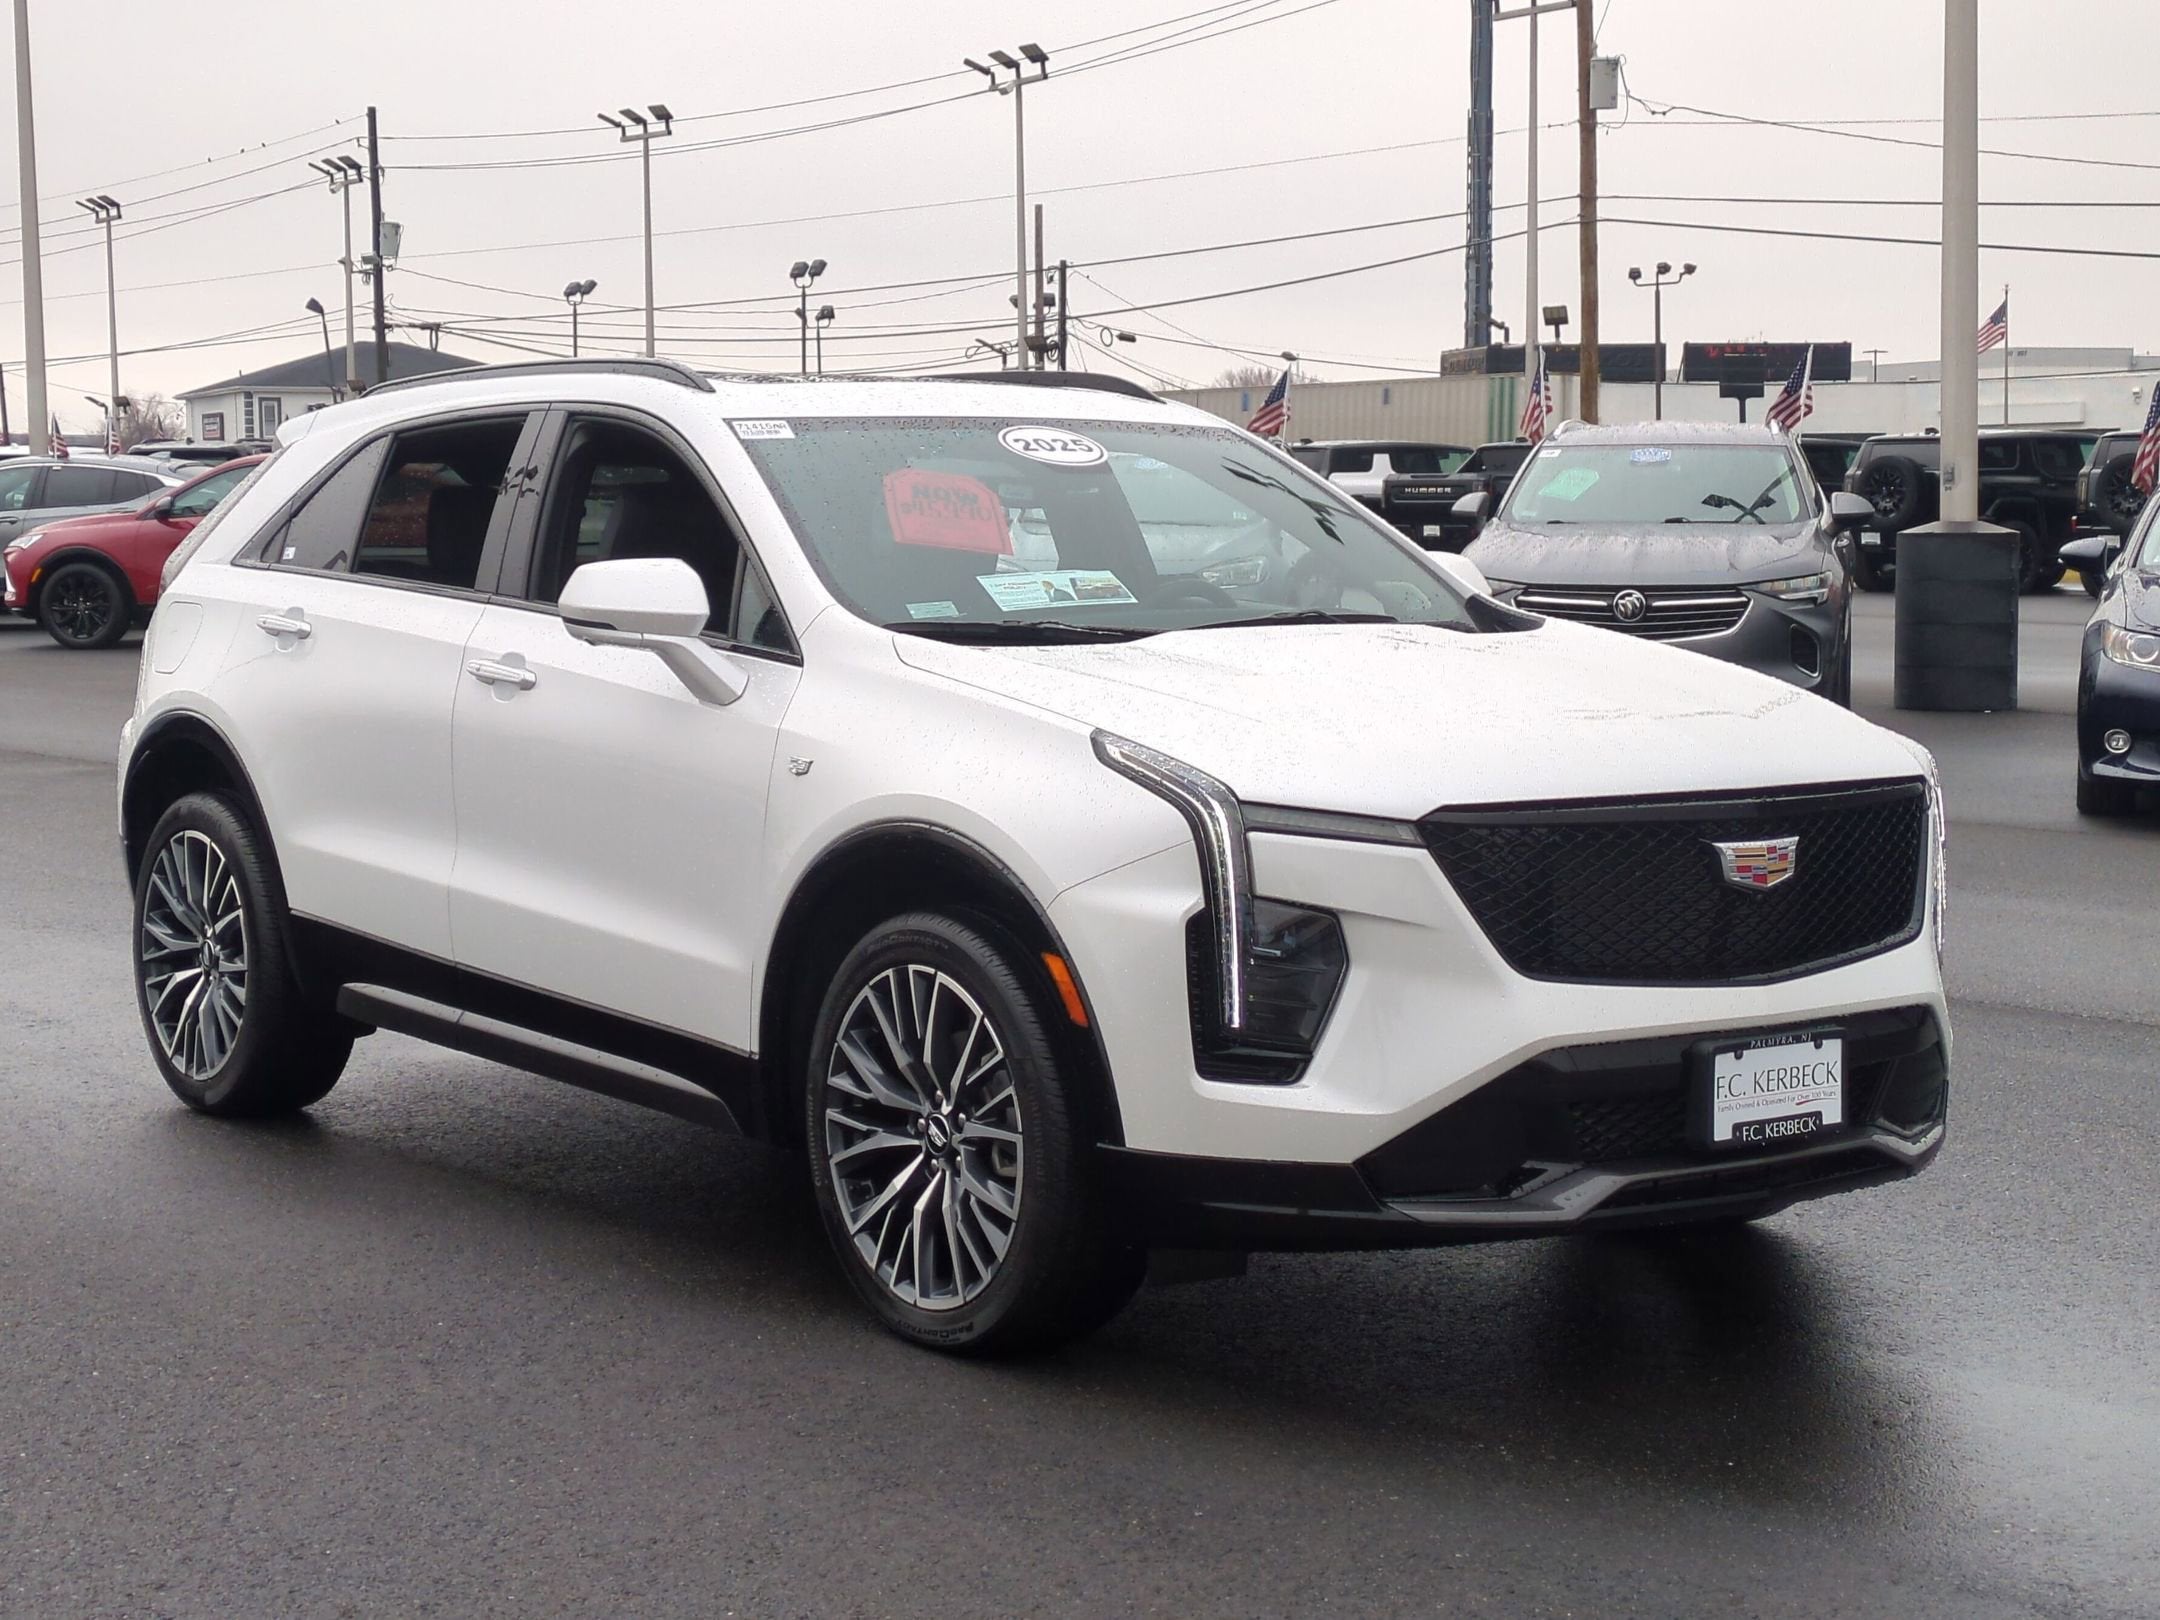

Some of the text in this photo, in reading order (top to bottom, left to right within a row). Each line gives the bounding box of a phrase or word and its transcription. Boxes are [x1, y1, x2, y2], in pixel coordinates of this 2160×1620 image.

[1012, 438, 1094, 453] 2025
[1716, 1061, 1839, 1100] F.C. KERBECK
[1742, 1116, 1817, 1142] F.C. KERBECK
